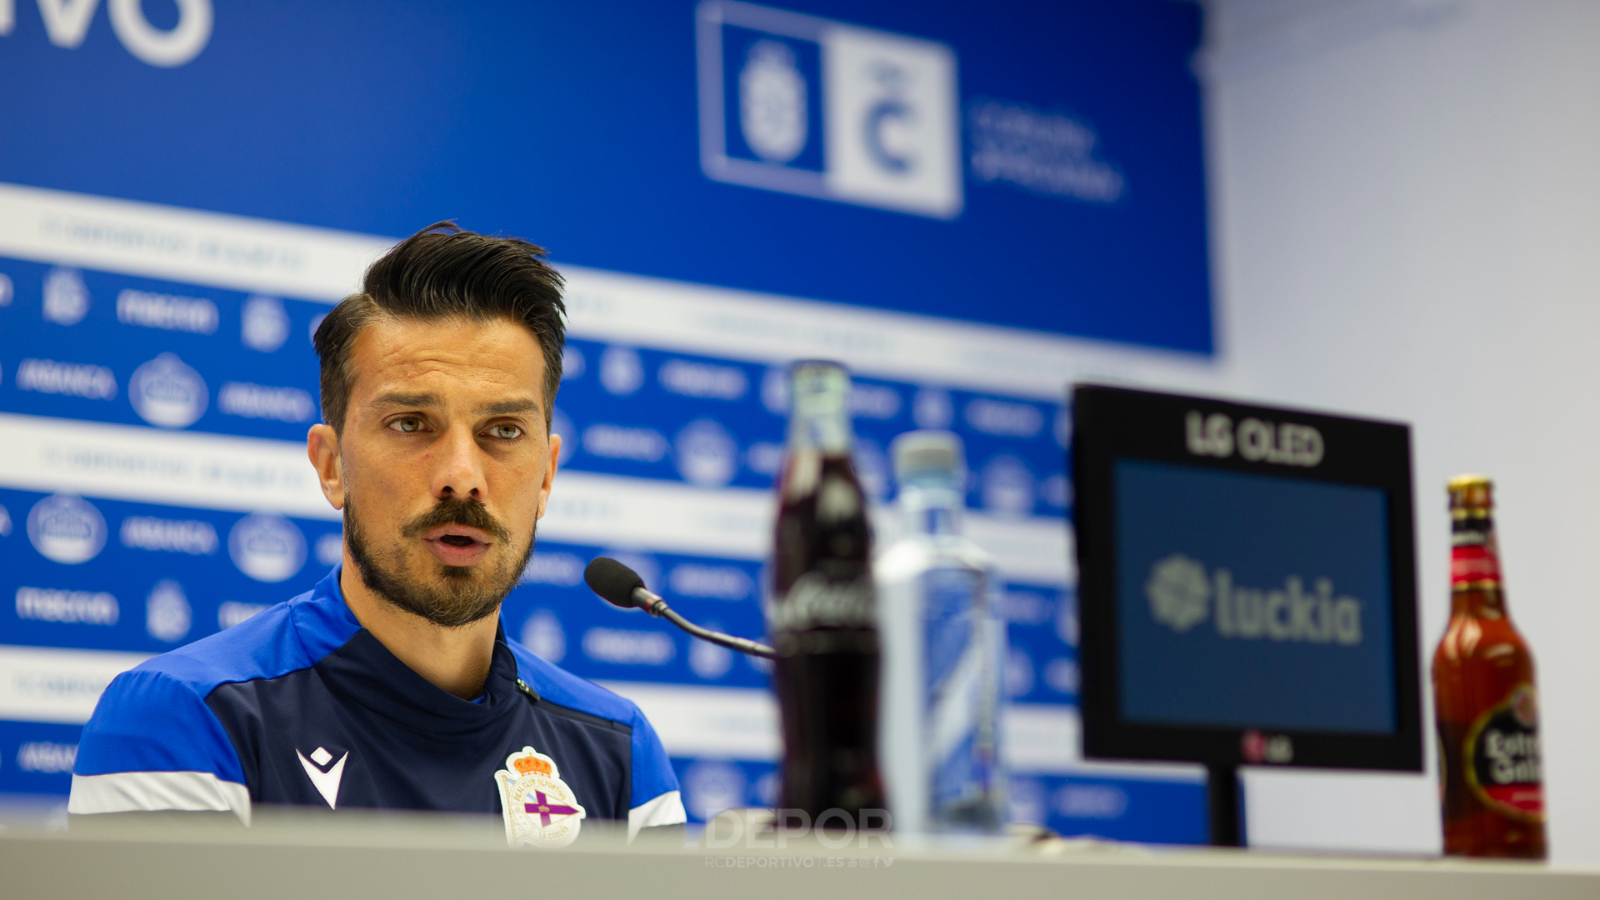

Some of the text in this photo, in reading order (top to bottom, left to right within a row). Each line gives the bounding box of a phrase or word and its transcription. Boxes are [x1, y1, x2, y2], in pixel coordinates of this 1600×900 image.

[1185, 410, 1325, 467] LG OLED
[1214, 568, 1362, 645] luckia
